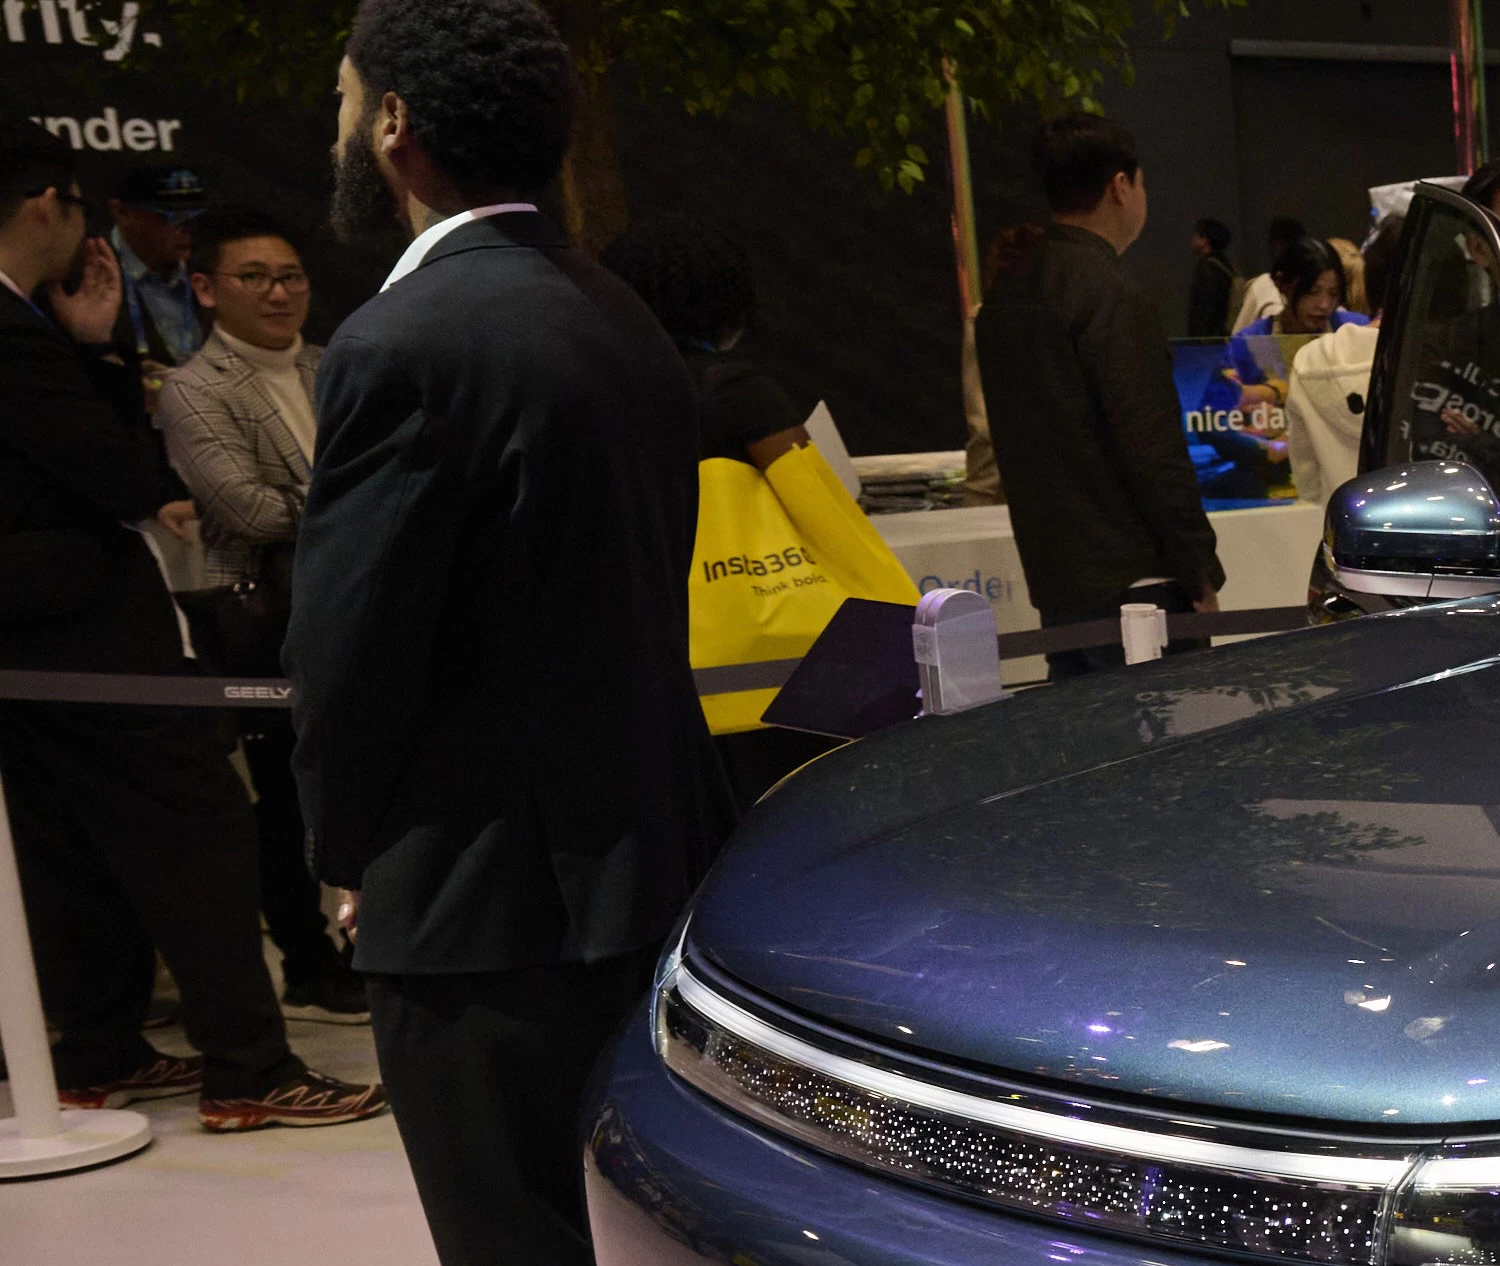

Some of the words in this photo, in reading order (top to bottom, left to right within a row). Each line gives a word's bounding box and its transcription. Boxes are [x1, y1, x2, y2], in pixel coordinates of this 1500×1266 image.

[29, 107, 181, 150] nder
[1186, 405, 1244, 432] nice
[751, 581, 789, 597] Think
[224, 686, 293, 699] GEELY
